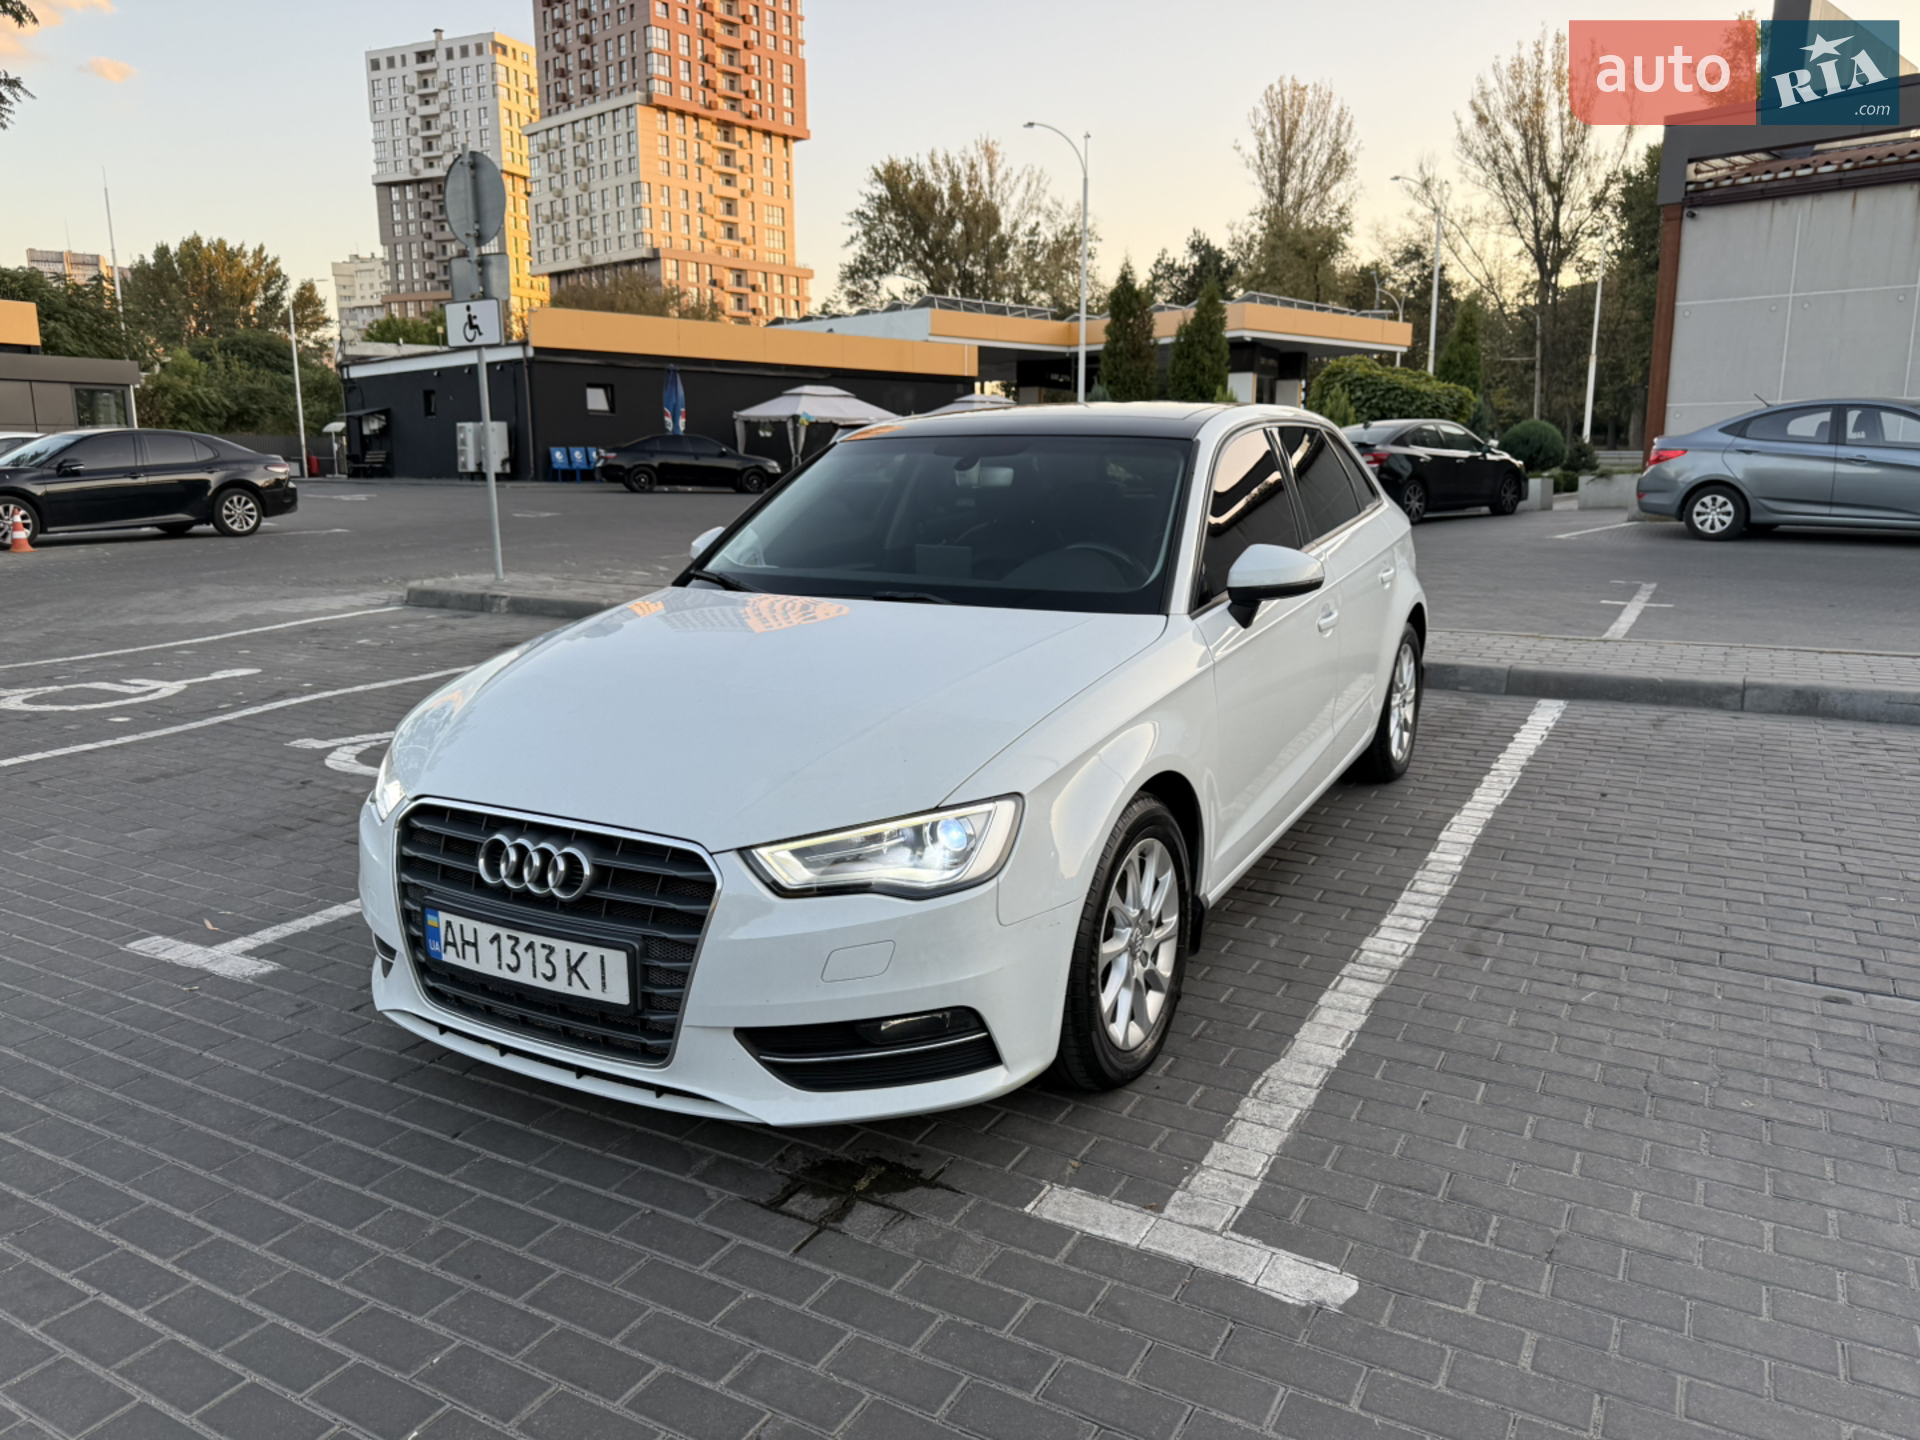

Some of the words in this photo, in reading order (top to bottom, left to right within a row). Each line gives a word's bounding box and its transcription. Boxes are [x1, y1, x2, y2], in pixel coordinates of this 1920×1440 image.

[428, 938, 441, 952] UA
[442, 919, 480, 964] AH
[489, 932, 557, 982] 1313
